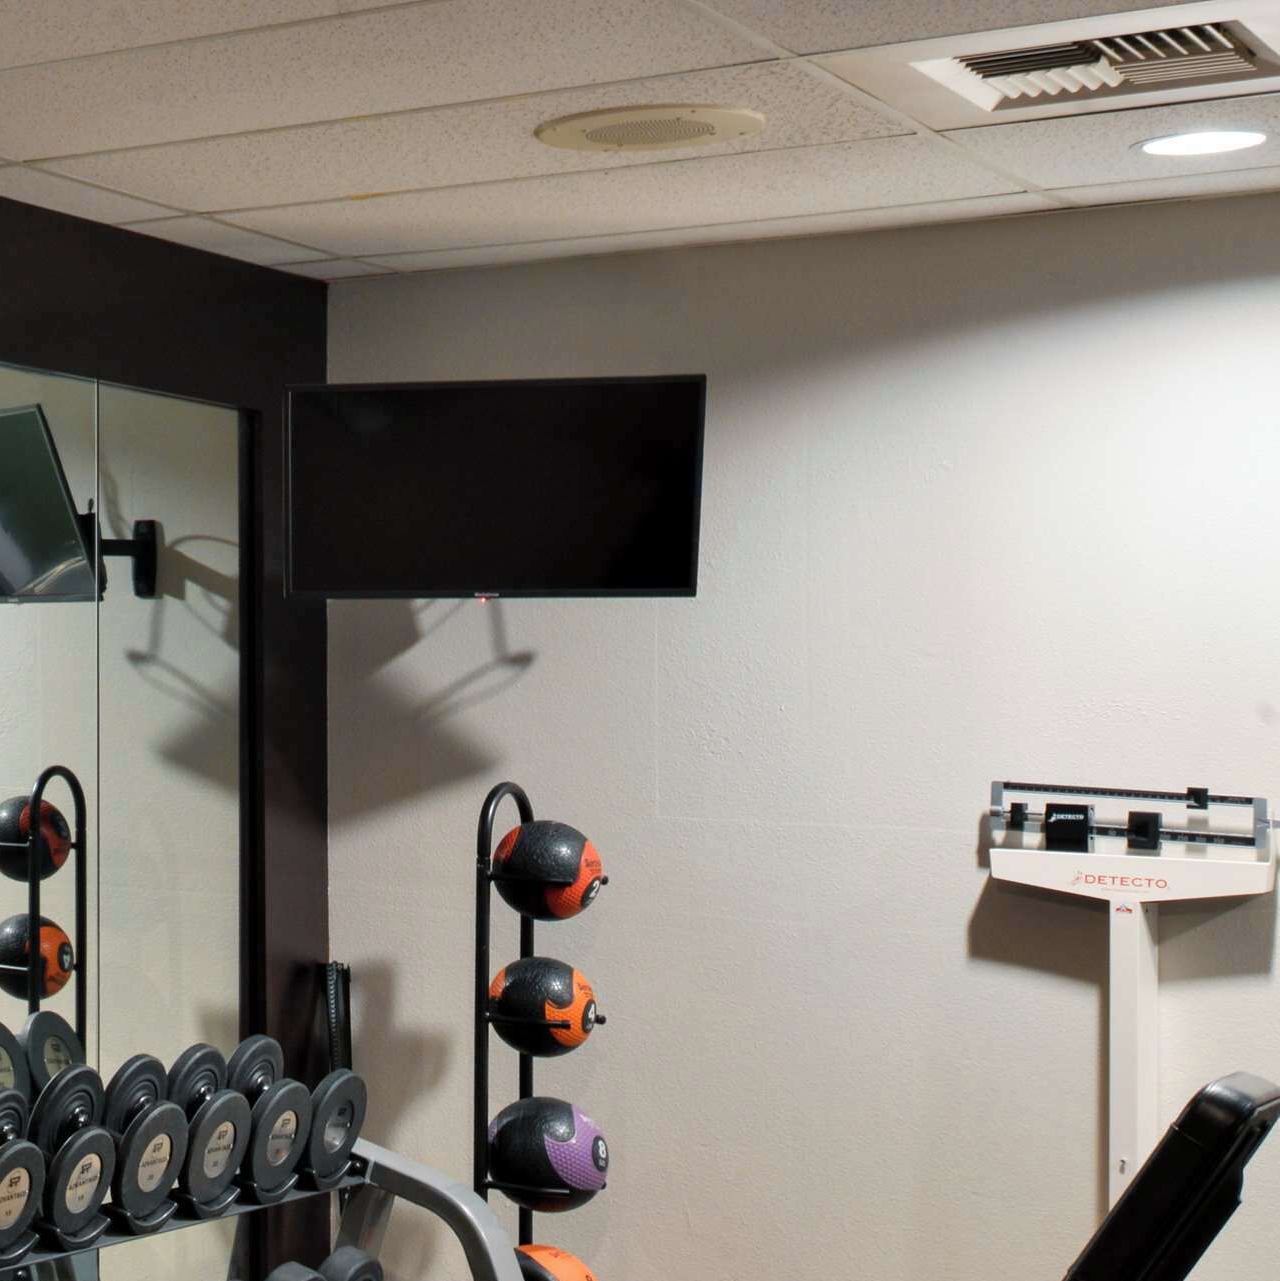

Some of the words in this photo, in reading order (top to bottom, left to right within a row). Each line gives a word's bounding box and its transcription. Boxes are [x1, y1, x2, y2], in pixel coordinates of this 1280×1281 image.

[589, 880, 600, 897] 2
[1084, 874, 1168, 889] DETECTO
[588, 1003, 595, 1022] 4
[598, 1140, 607, 1158] 8
